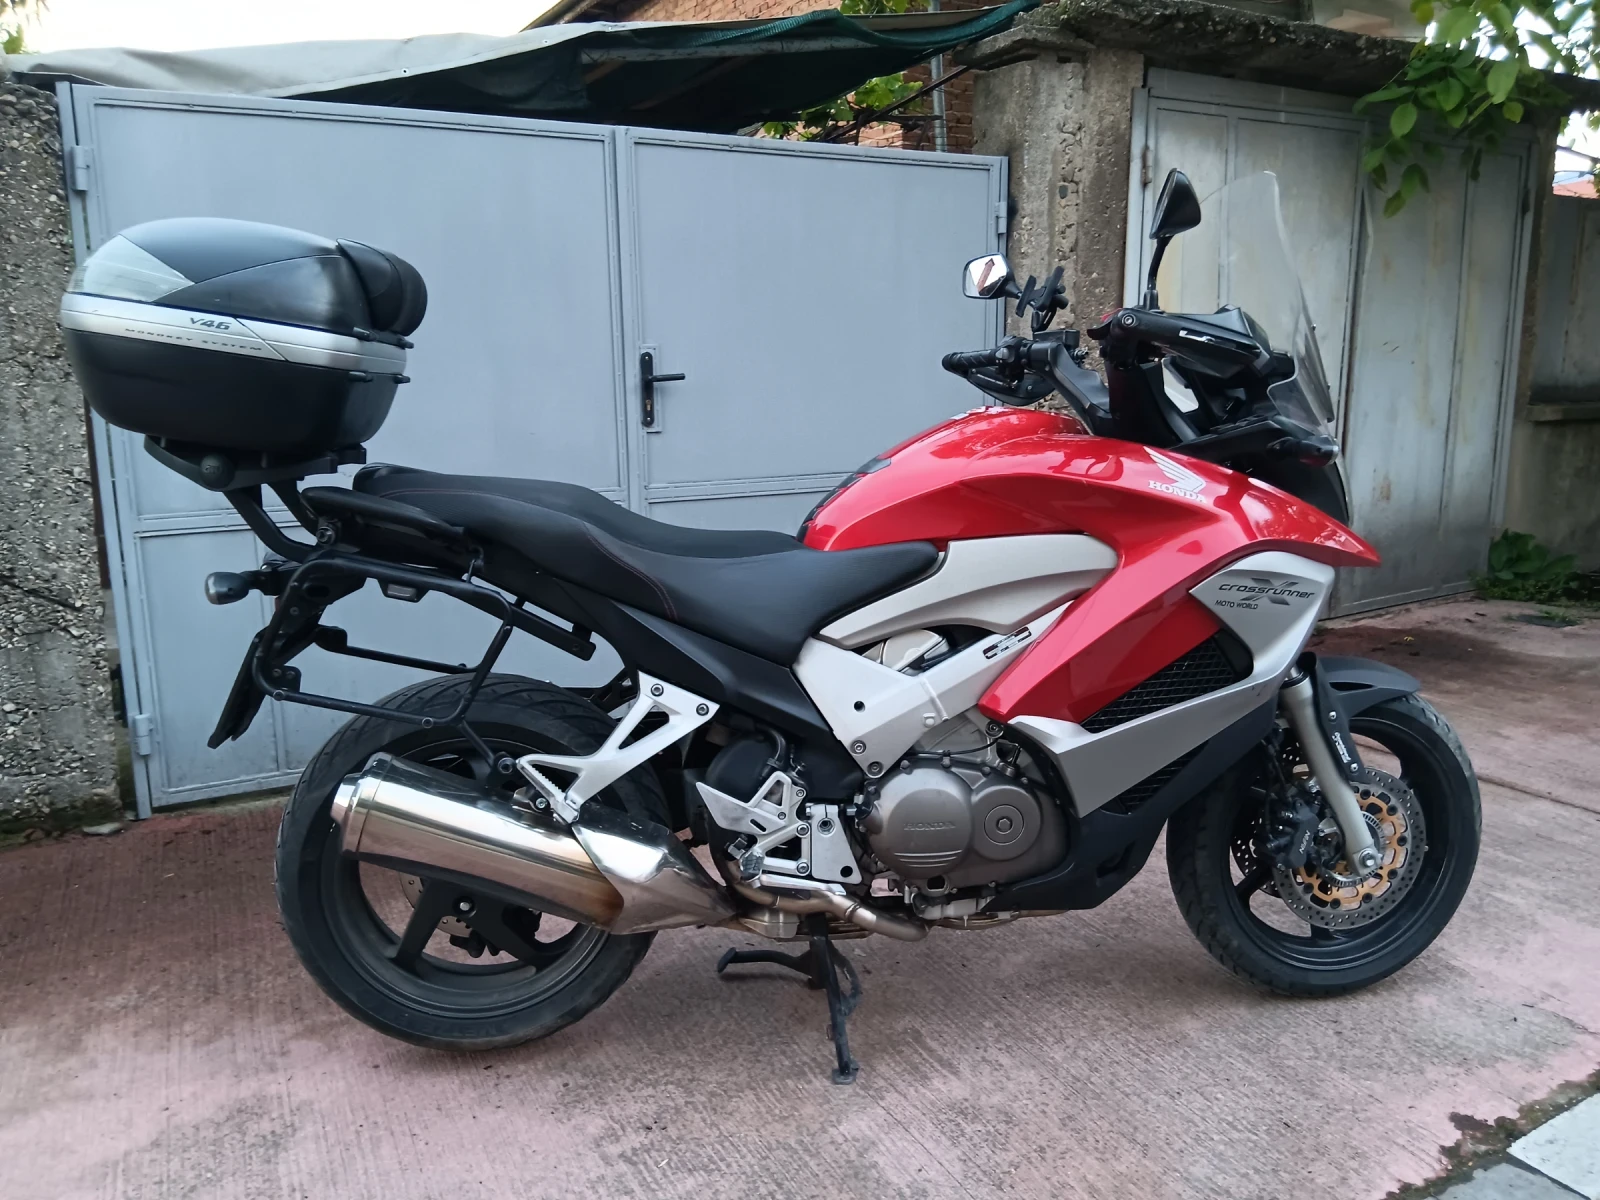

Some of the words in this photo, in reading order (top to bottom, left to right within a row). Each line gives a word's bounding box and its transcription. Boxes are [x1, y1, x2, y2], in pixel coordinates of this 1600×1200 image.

[190, 317, 232, 331] V46
[201, 340, 262, 351] SYSTEM
[1148, 480, 1207, 503] HONDA
[1218, 583, 1315, 599] crossrunner
[1214, 600, 1235, 608] MOTO
[1236, 602, 1259, 610] WORLD
[903, 821, 956, 831] HONDA
